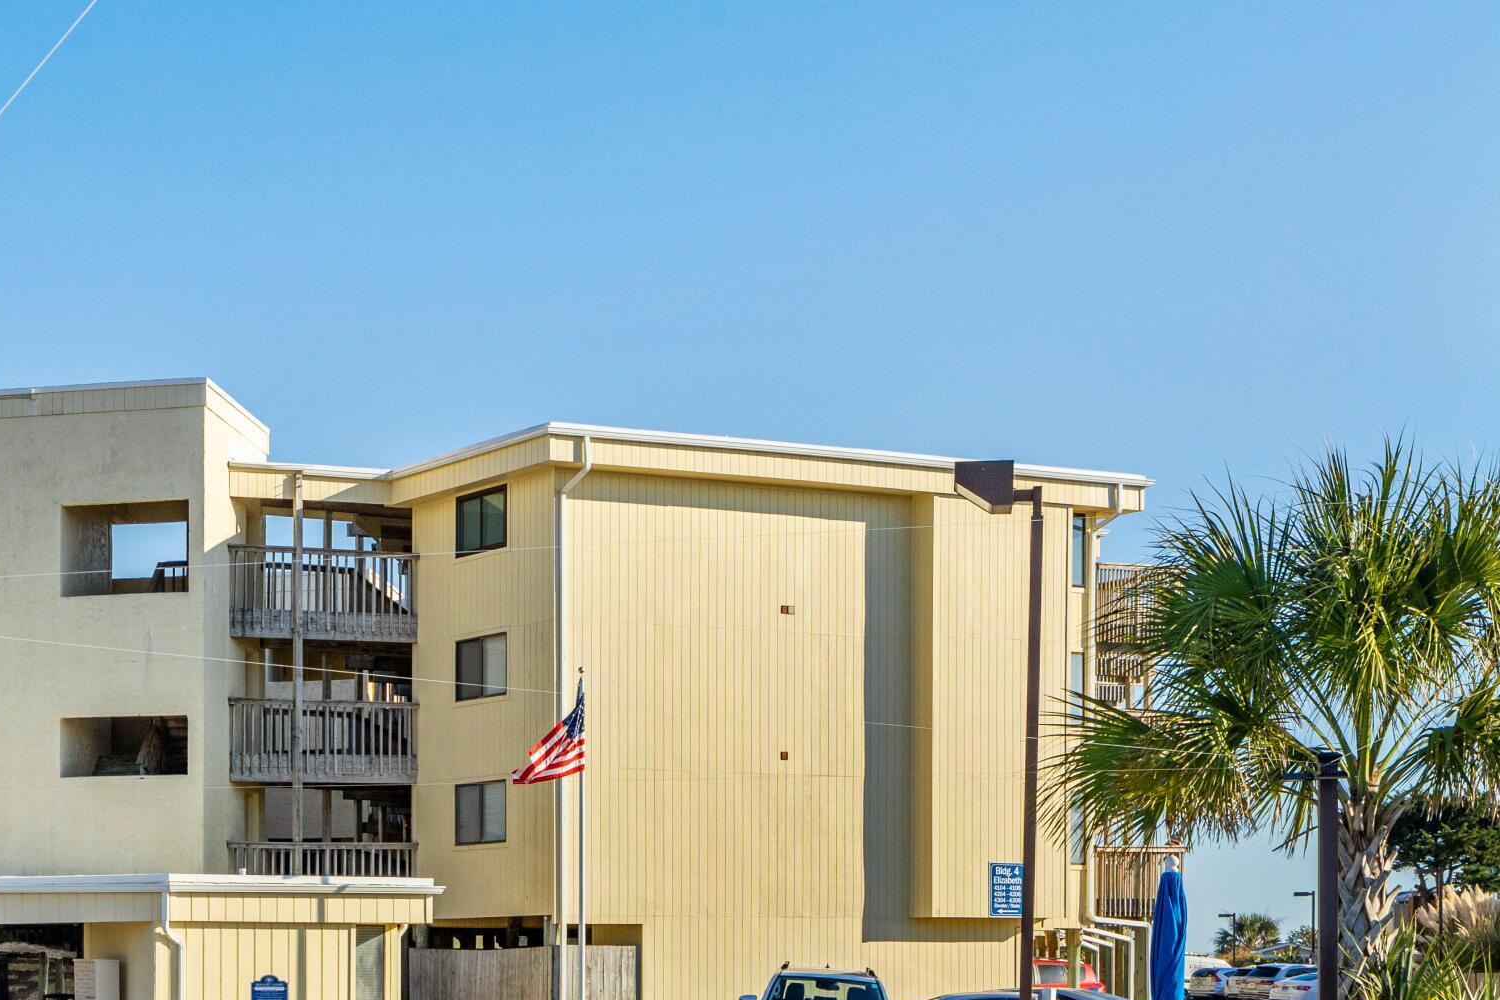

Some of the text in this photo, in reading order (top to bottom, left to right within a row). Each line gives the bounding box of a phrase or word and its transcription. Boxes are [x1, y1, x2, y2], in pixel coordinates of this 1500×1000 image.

[995, 866, 1019, 876] Bldg. 4
[993, 876, 1022, 884] Elizabeth
